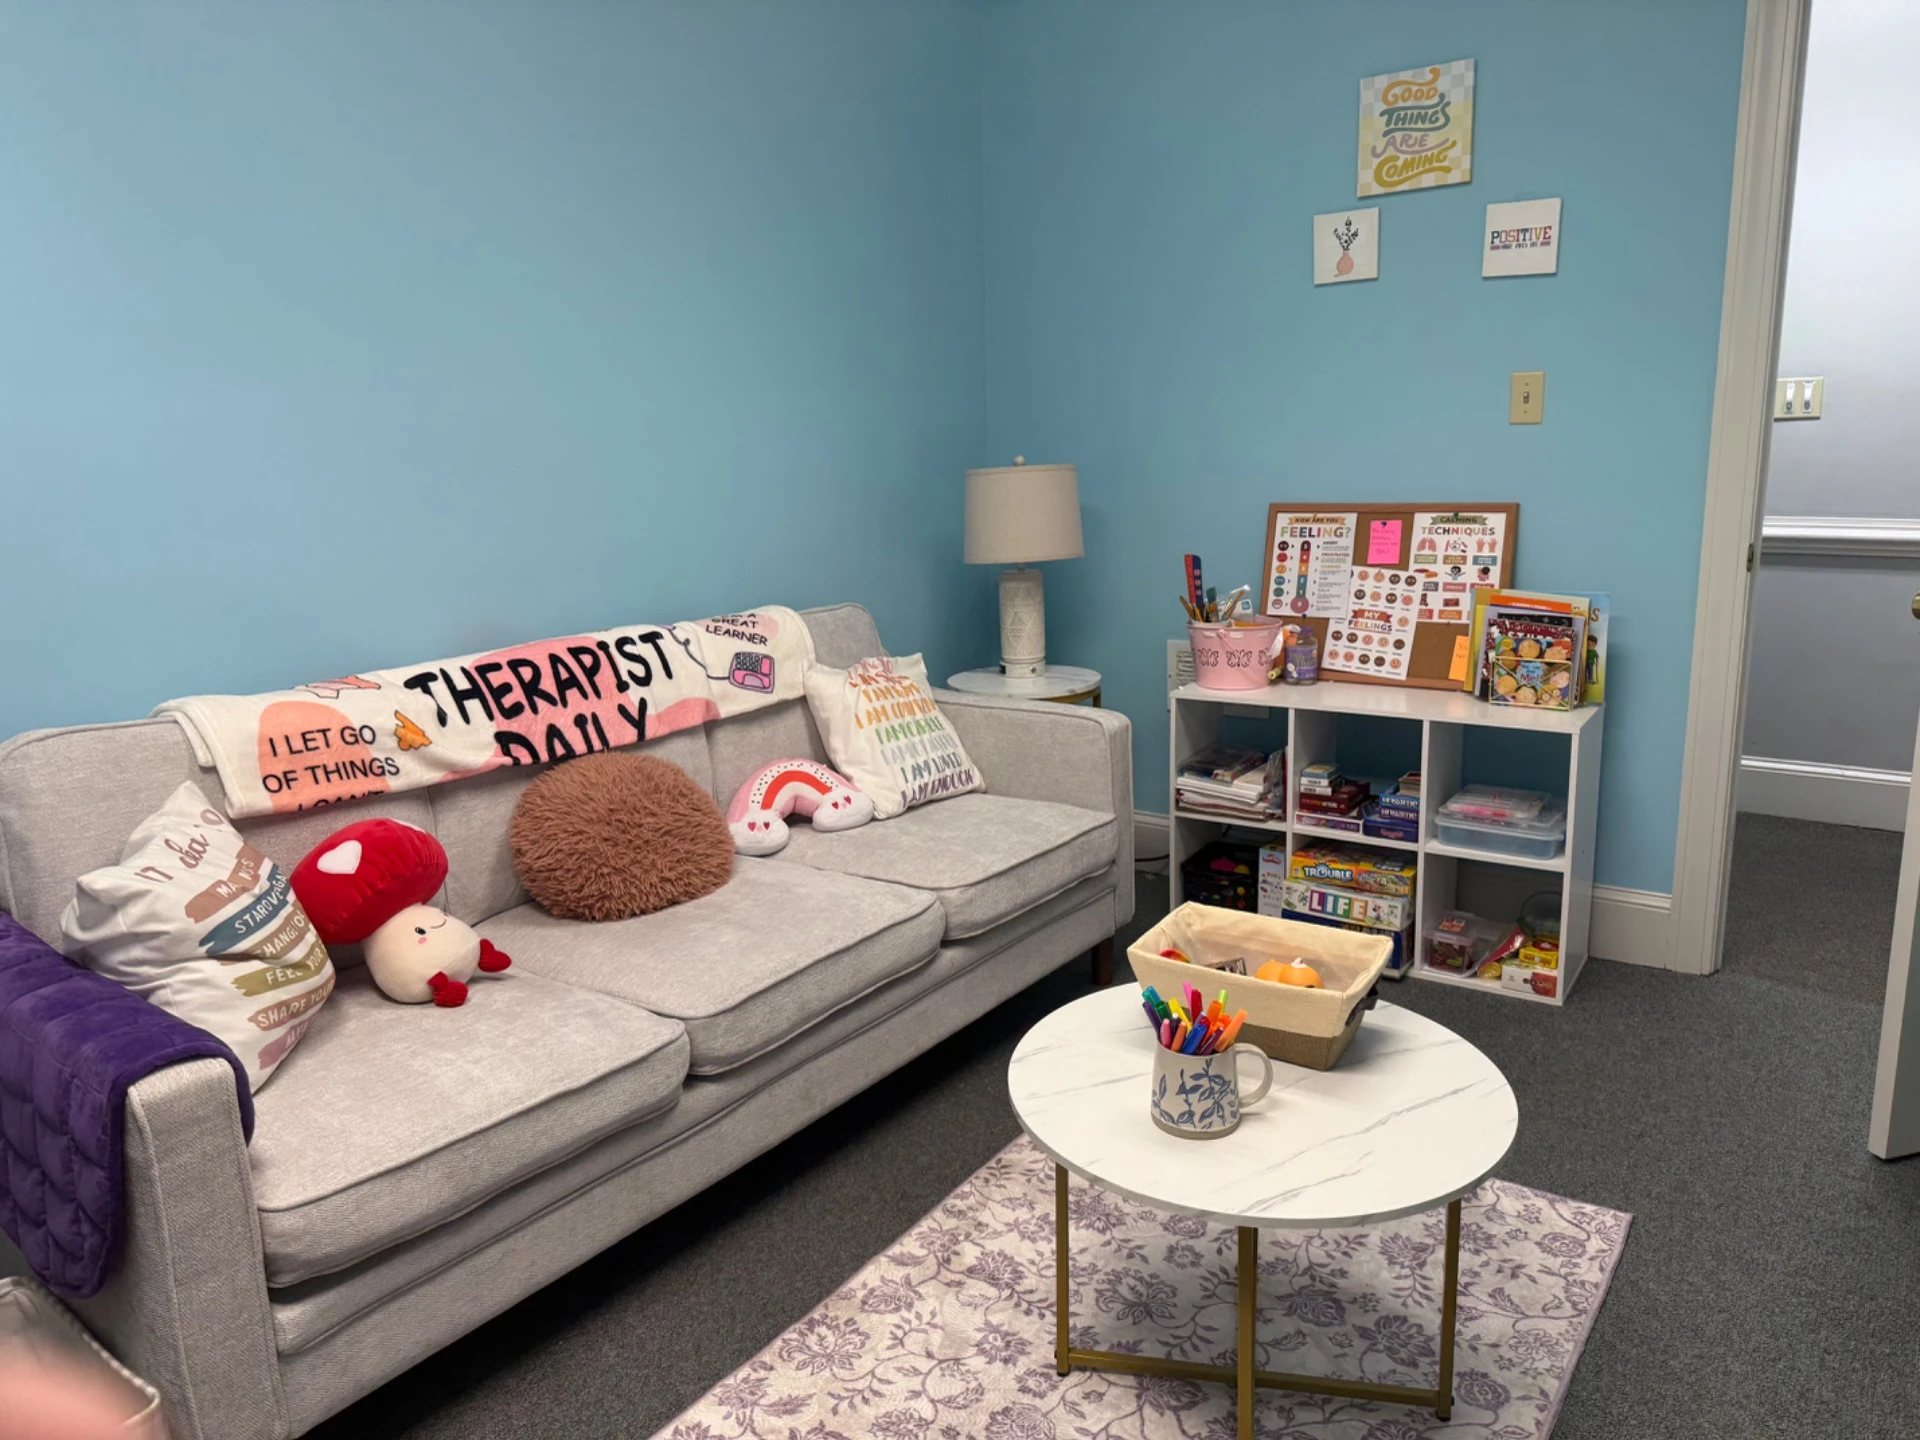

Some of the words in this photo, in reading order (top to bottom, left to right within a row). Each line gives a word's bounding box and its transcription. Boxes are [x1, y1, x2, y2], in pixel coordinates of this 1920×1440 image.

[1382, 67, 1440, 107] GOOD
[1379, 93, 1451, 138] THINGS
[1371, 133, 1449, 158] ARE
[1374, 140, 1457, 188] COMING
[1491, 226, 1552, 244] POSITIVE
[1280, 526, 1351, 538] FEELING?
[1421, 526, 1495, 537] TECHNIQUES
[711, 617, 759, 629] GREAT
[1348, 619, 1393, 631] FEELINGS
[1364, 611, 1380, 619] MY
[706, 624, 768, 647] LEARNER
[403, 631, 674, 728] THERAPIST
[268, 737, 278, 757] I
[284, 728, 331, 755] LET
[340, 724, 376, 746] GO
[262, 770, 299, 794] OF
[304, 757, 400, 785] THINGS
[1303, 863, 1353, 882] TROUBLE
[1311, 892, 1365, 919] LIFE
[257, 998, 306, 1028] SHARE
